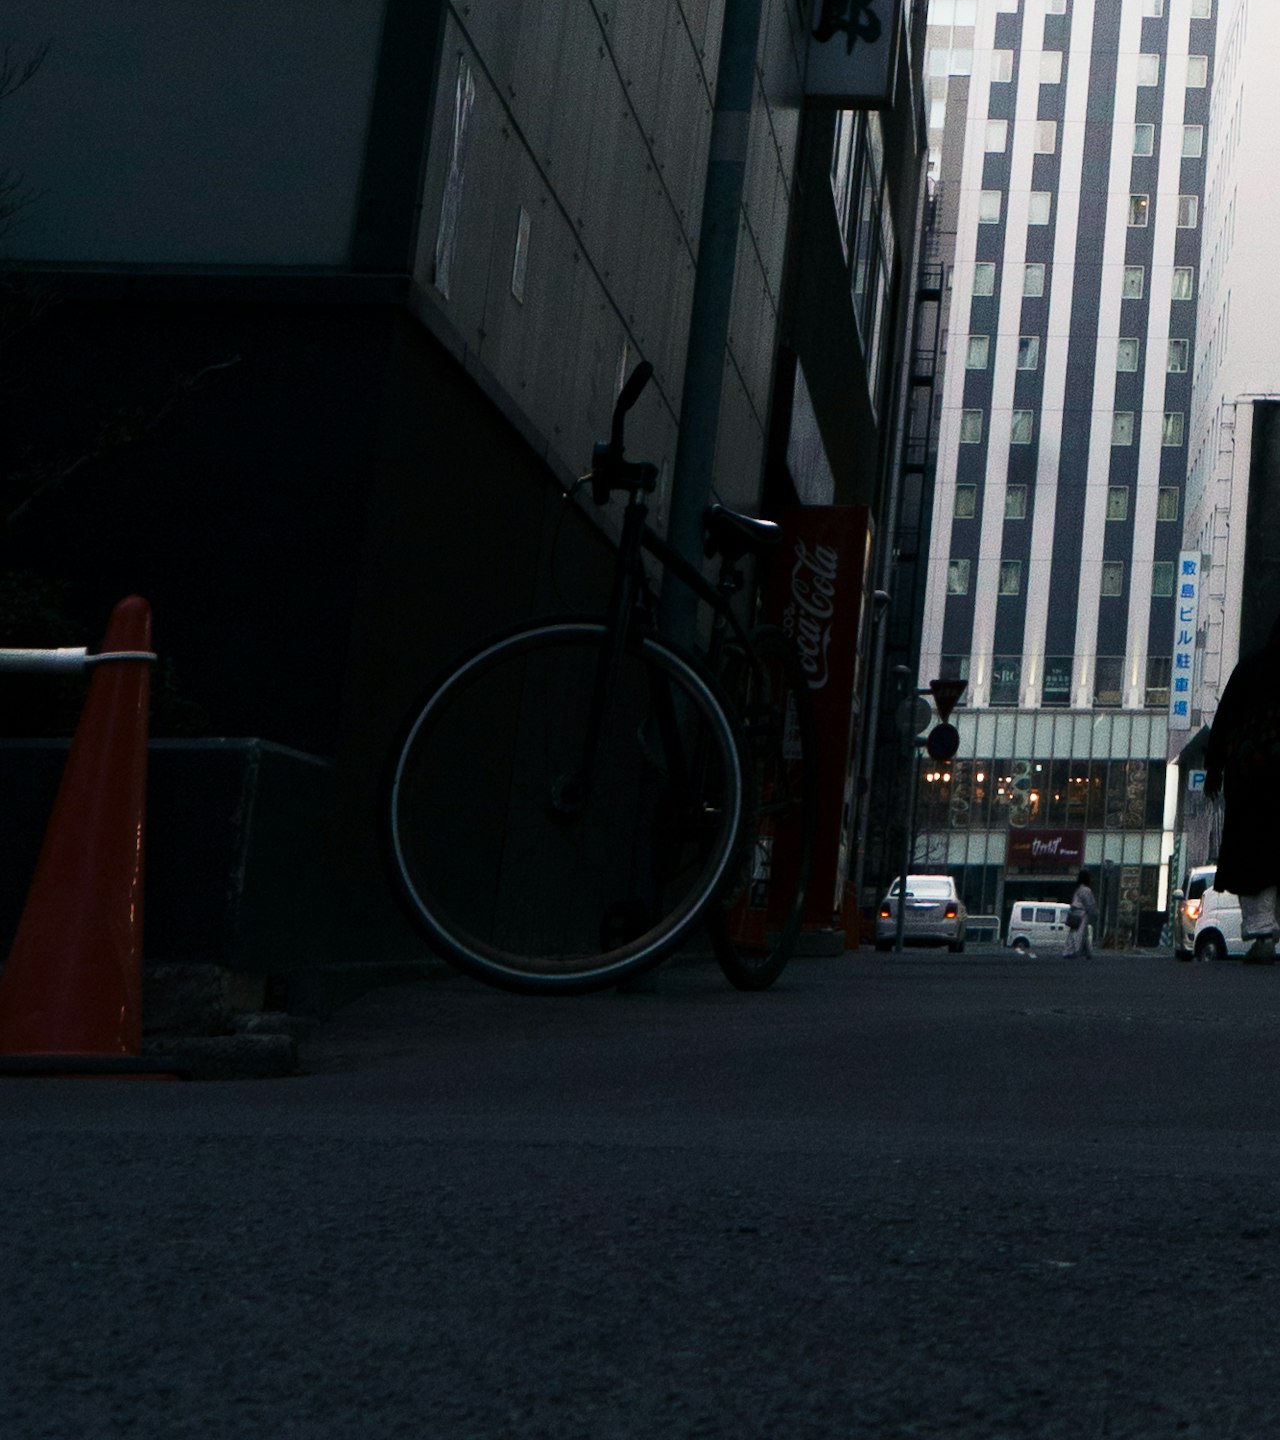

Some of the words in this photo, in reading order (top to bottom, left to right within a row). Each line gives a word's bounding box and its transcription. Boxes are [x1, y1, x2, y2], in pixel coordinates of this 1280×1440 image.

[1172, 560, 1198, 718] 敷島ビル駐車場
